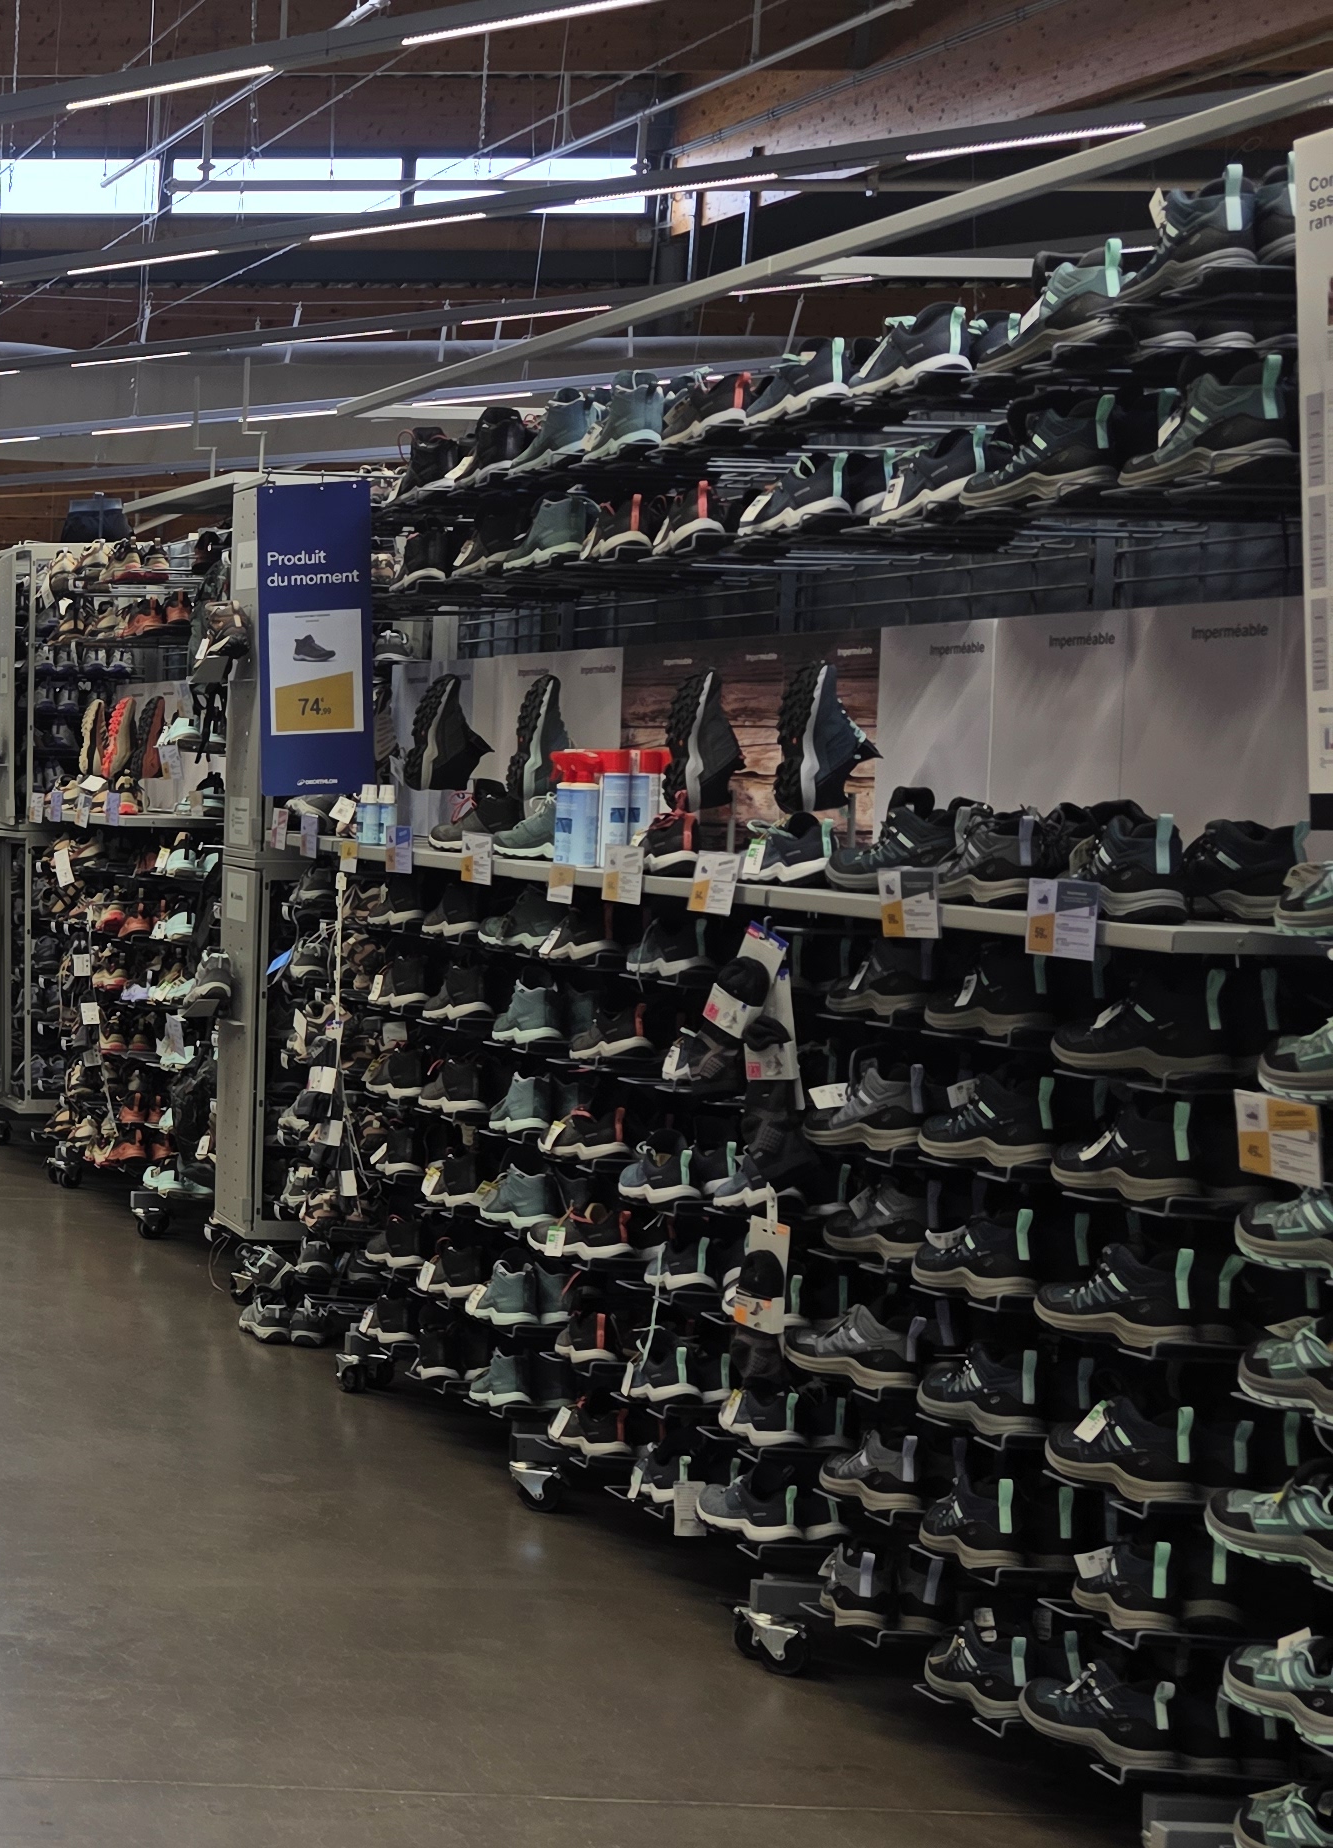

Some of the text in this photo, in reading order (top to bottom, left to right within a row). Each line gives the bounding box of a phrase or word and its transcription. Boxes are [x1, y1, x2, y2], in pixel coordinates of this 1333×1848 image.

[267, 549, 326, 567] Produit
[267, 569, 360, 587] du moment
[1048, 632, 1116, 651] Imperméable
[1190, 623, 1270, 643] Imperméable
[929, 641, 985, 657] Imperméable
